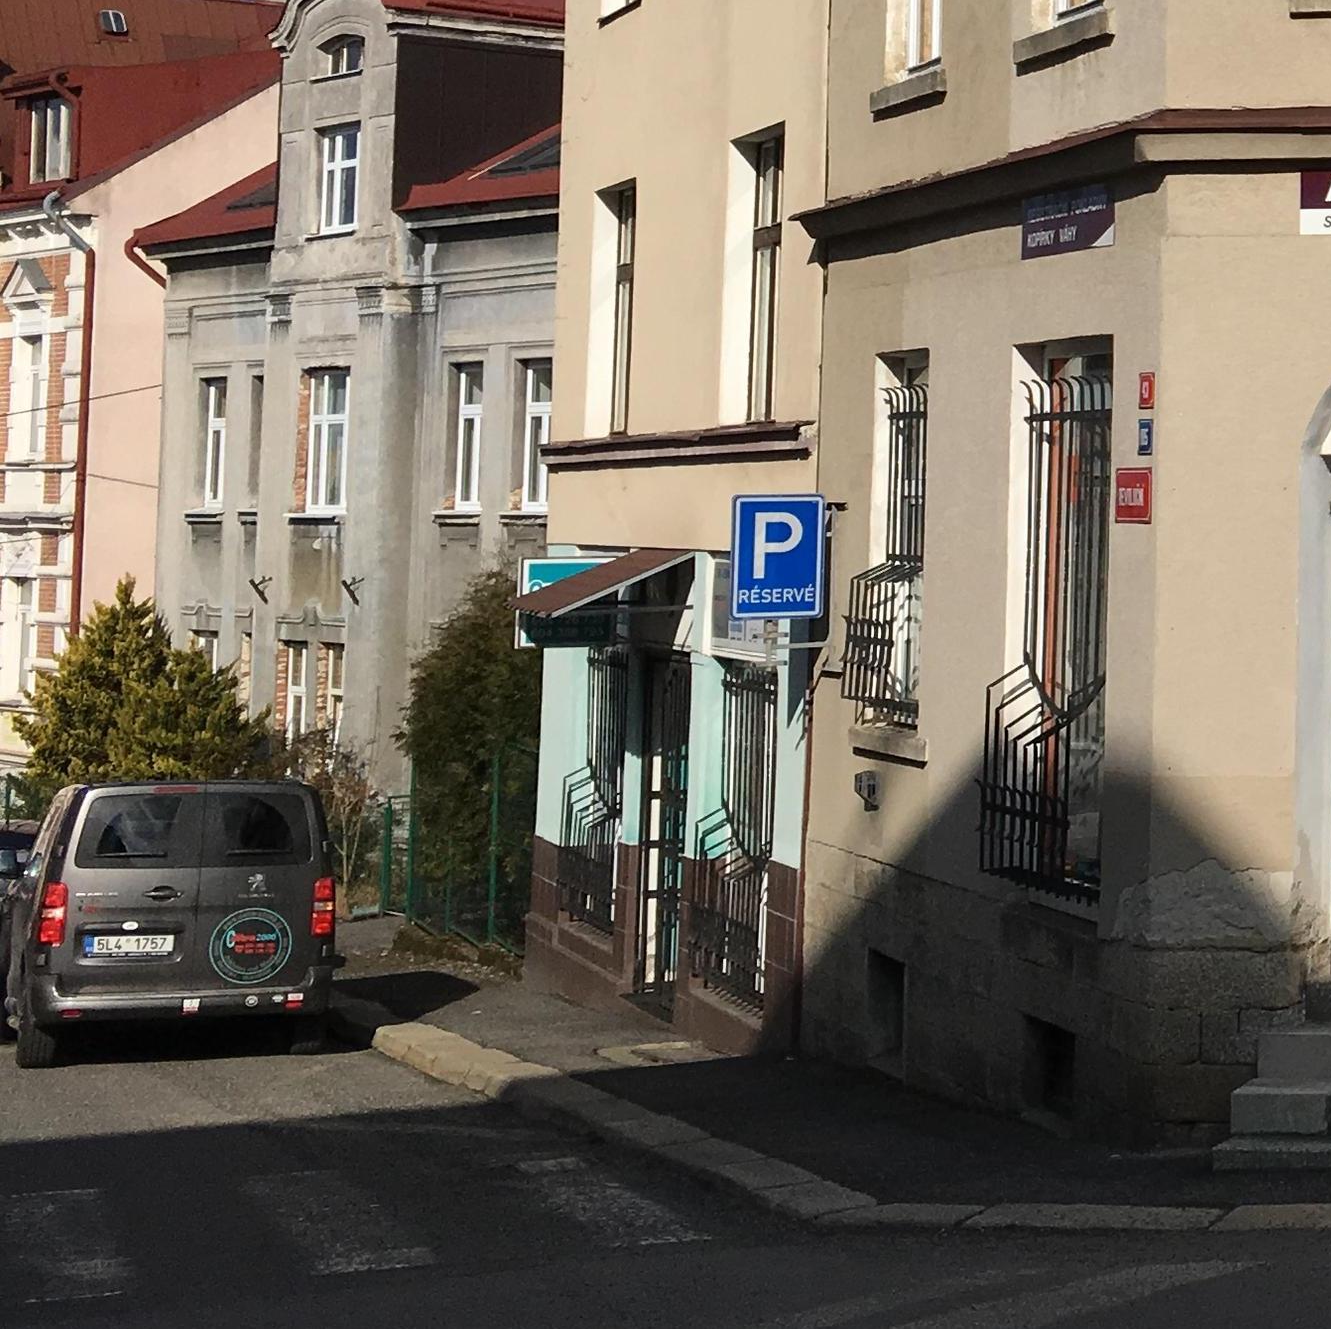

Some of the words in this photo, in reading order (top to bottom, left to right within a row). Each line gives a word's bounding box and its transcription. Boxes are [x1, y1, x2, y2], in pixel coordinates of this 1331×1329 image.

[753, 512, 803, 579] P
[738, 584, 815, 604] RÉSERVÉ
[97, 938, 122, 950] 5L4
[135, 937, 167, 950] 1757
